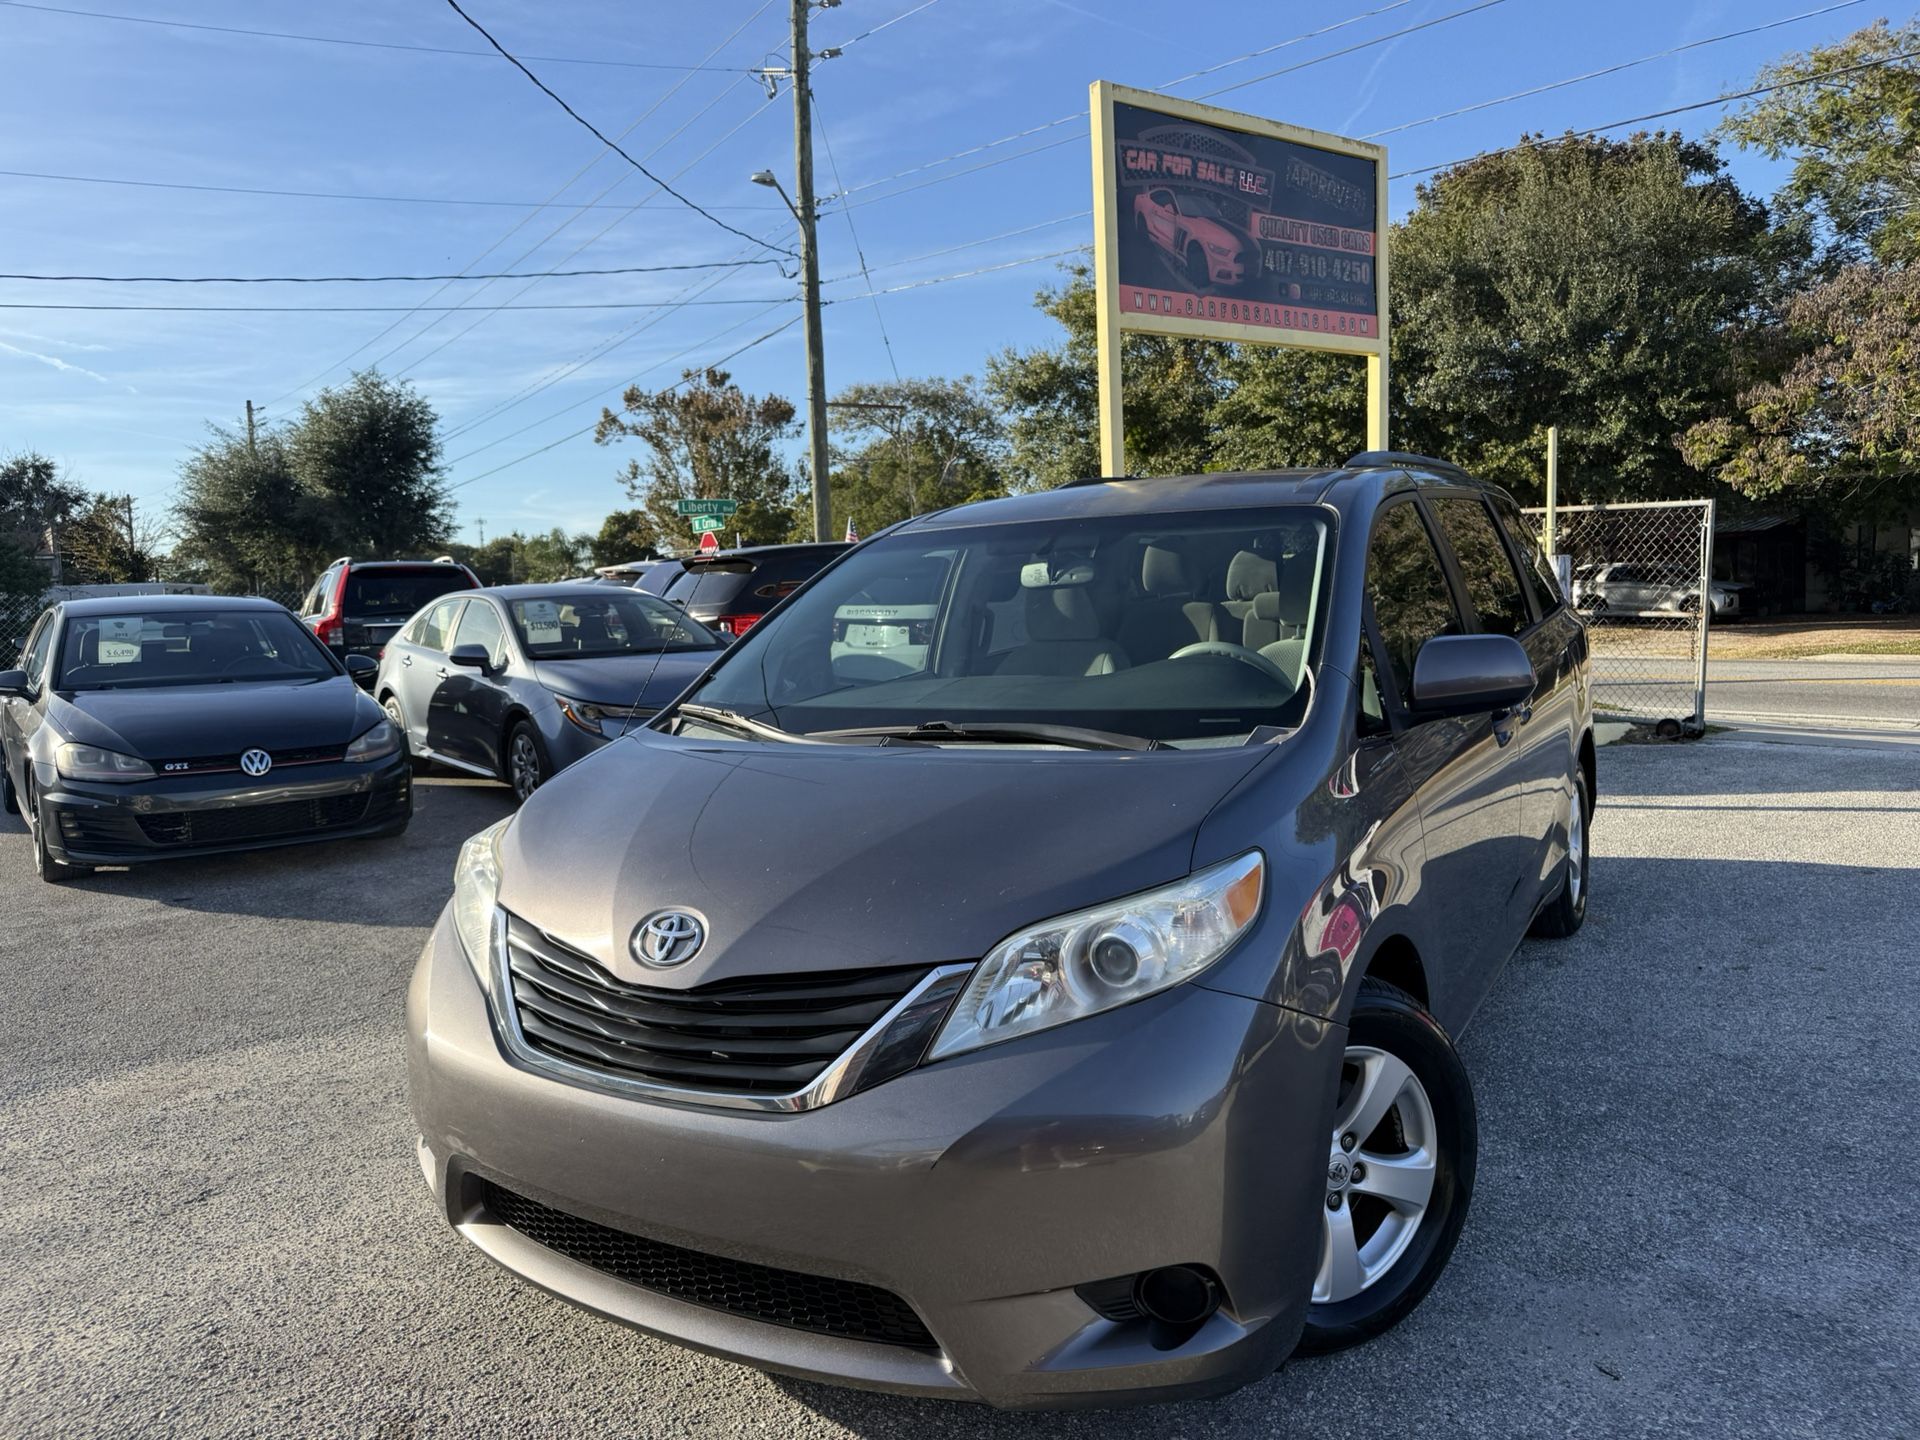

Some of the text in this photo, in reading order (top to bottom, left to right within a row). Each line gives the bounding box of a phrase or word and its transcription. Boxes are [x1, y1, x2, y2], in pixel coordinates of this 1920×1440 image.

[1126, 149, 1157, 172] CAR
[1162, 154, 1192, 176] FOR
[1196, 161, 1234, 185] SALE
[1260, 216, 1371, 252] QUALITY USED CARS
[682, 502, 718, 514] Liberty
[164, 762, 189, 770] GTI
